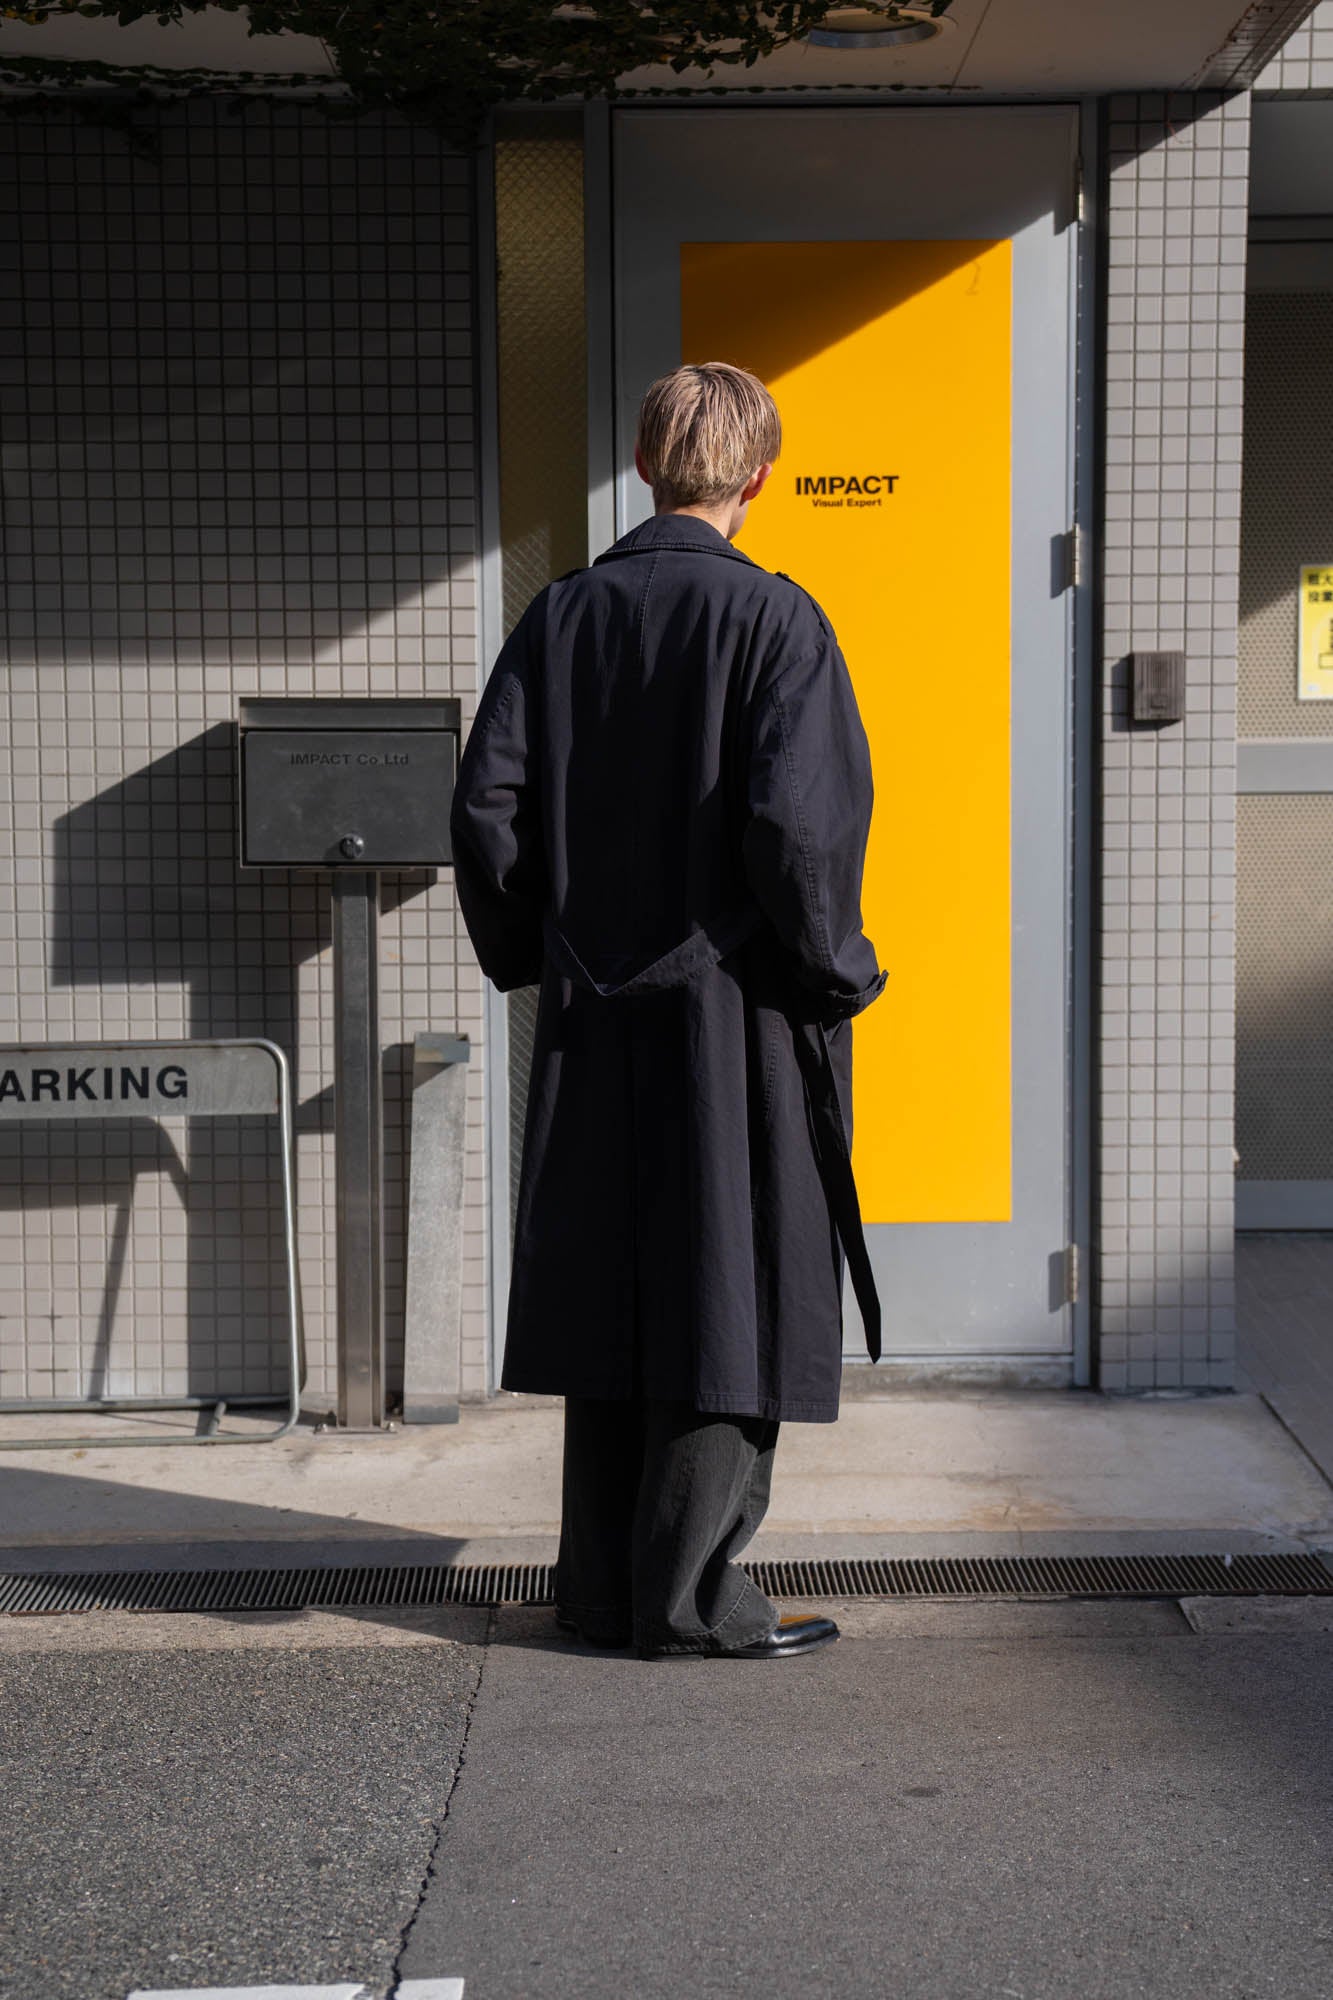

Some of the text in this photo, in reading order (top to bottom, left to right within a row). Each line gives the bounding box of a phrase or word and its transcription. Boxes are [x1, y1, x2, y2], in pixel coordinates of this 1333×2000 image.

[795, 475, 899, 495] IMPACT
[812, 498, 882, 508] Visual Expert
[290, 753, 352, 766] IMPACT
[0, 1065, 188, 1102] ARKING
